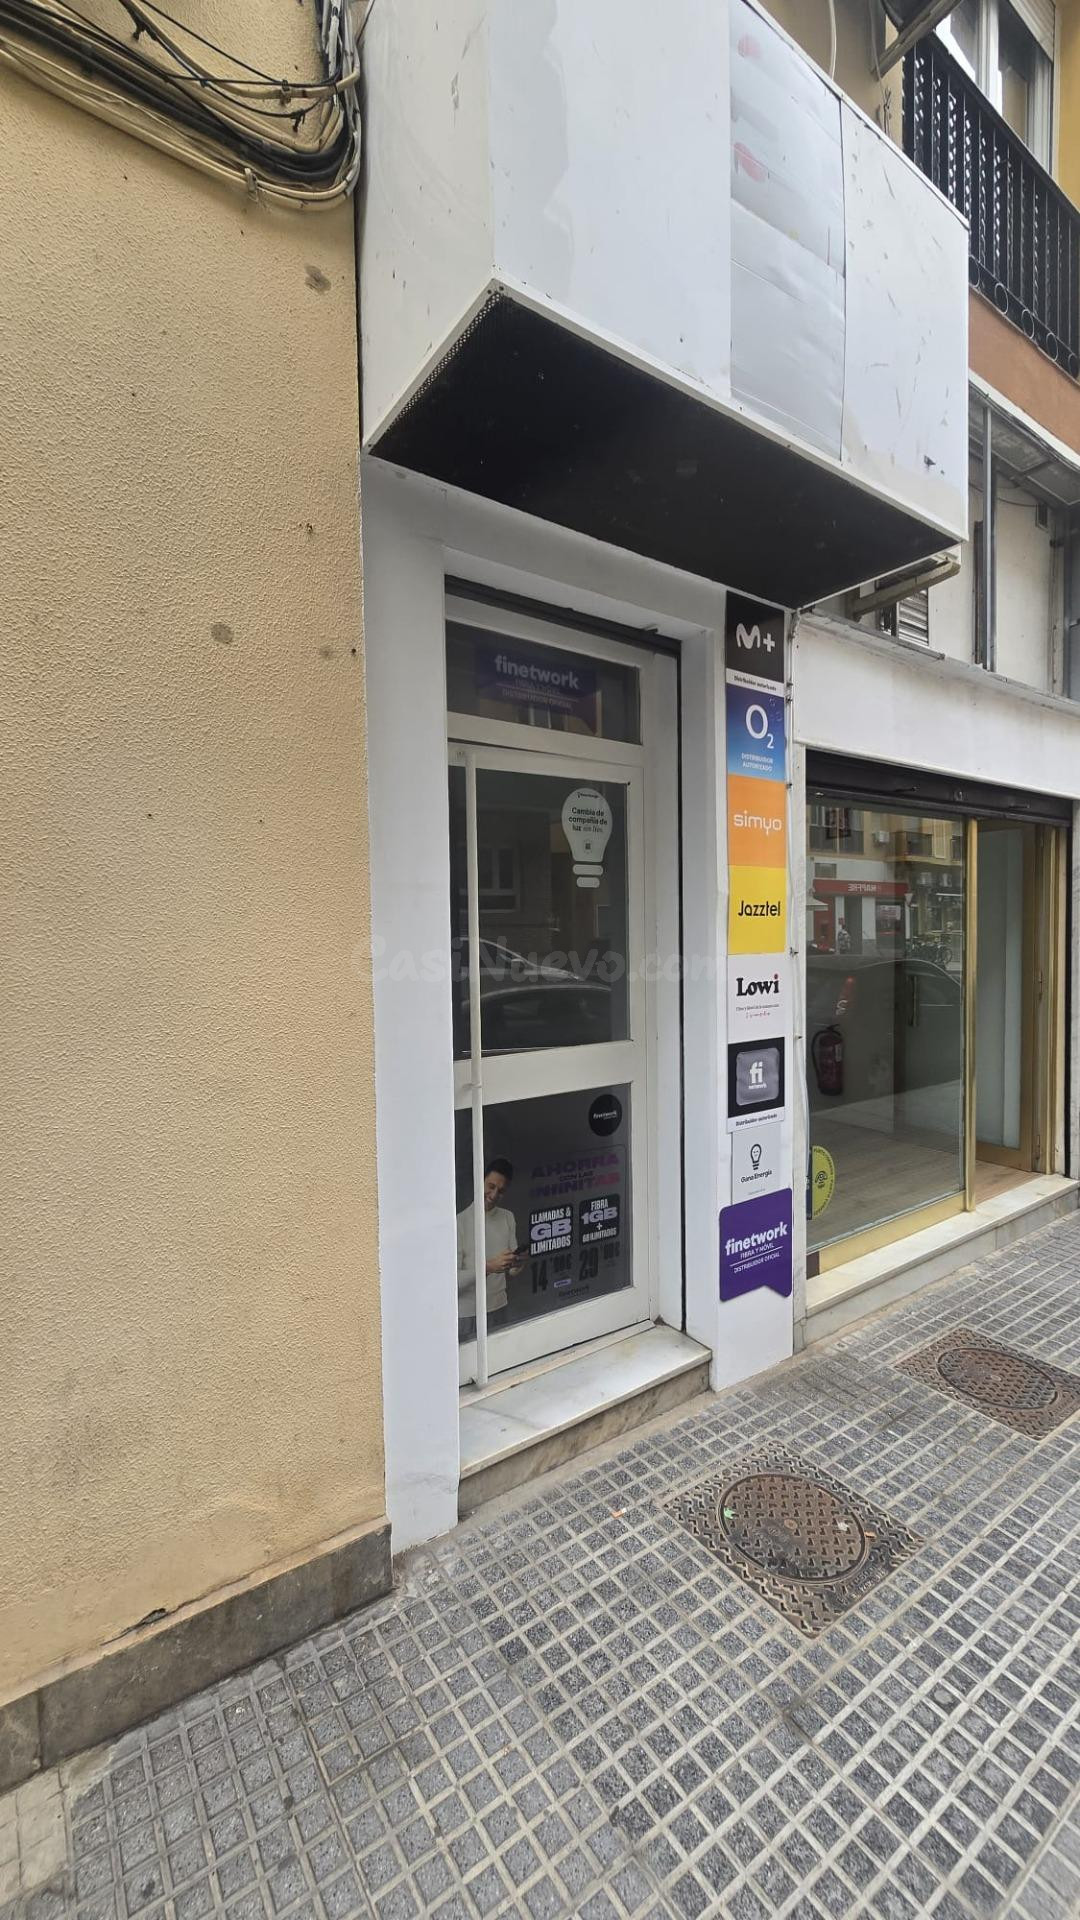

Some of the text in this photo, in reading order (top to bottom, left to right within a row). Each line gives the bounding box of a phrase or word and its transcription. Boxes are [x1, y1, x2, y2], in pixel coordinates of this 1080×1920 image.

[495, 654, 580, 690] finetwork
[741, 753, 773, 764] DISTRIBUIDOR
[742, 762, 773, 773] AUTORIZADO
[572, 807, 604, 817] Cambia de
[600, 817, 607, 825] de
[733, 810, 782, 836] simyo
[737, 900, 782, 917] Jazztel
[736, 973, 779, 996] Lowi
[750, 1061, 763, 1084] fi
[591, 1199, 608, 1211] FIBRA
[531, 1208, 564, 1225] LLAMADAS
[581, 1206, 618, 1225] 1GB
[531, 1218, 572, 1241] GB
[590, 1227, 617, 1242] ILIMITADOS
[725, 1221, 788, 1256] finetwork
[530, 1235, 571, 1256] ILIMITADOS
[740, 1250, 755, 1260] FIBRA
[759, 1242, 775, 1254] MÓVIL
[733, 1252, 780, 1274] DISTRIBUIDOR OFICIAL
[531, 1259, 548, 1294] 14
